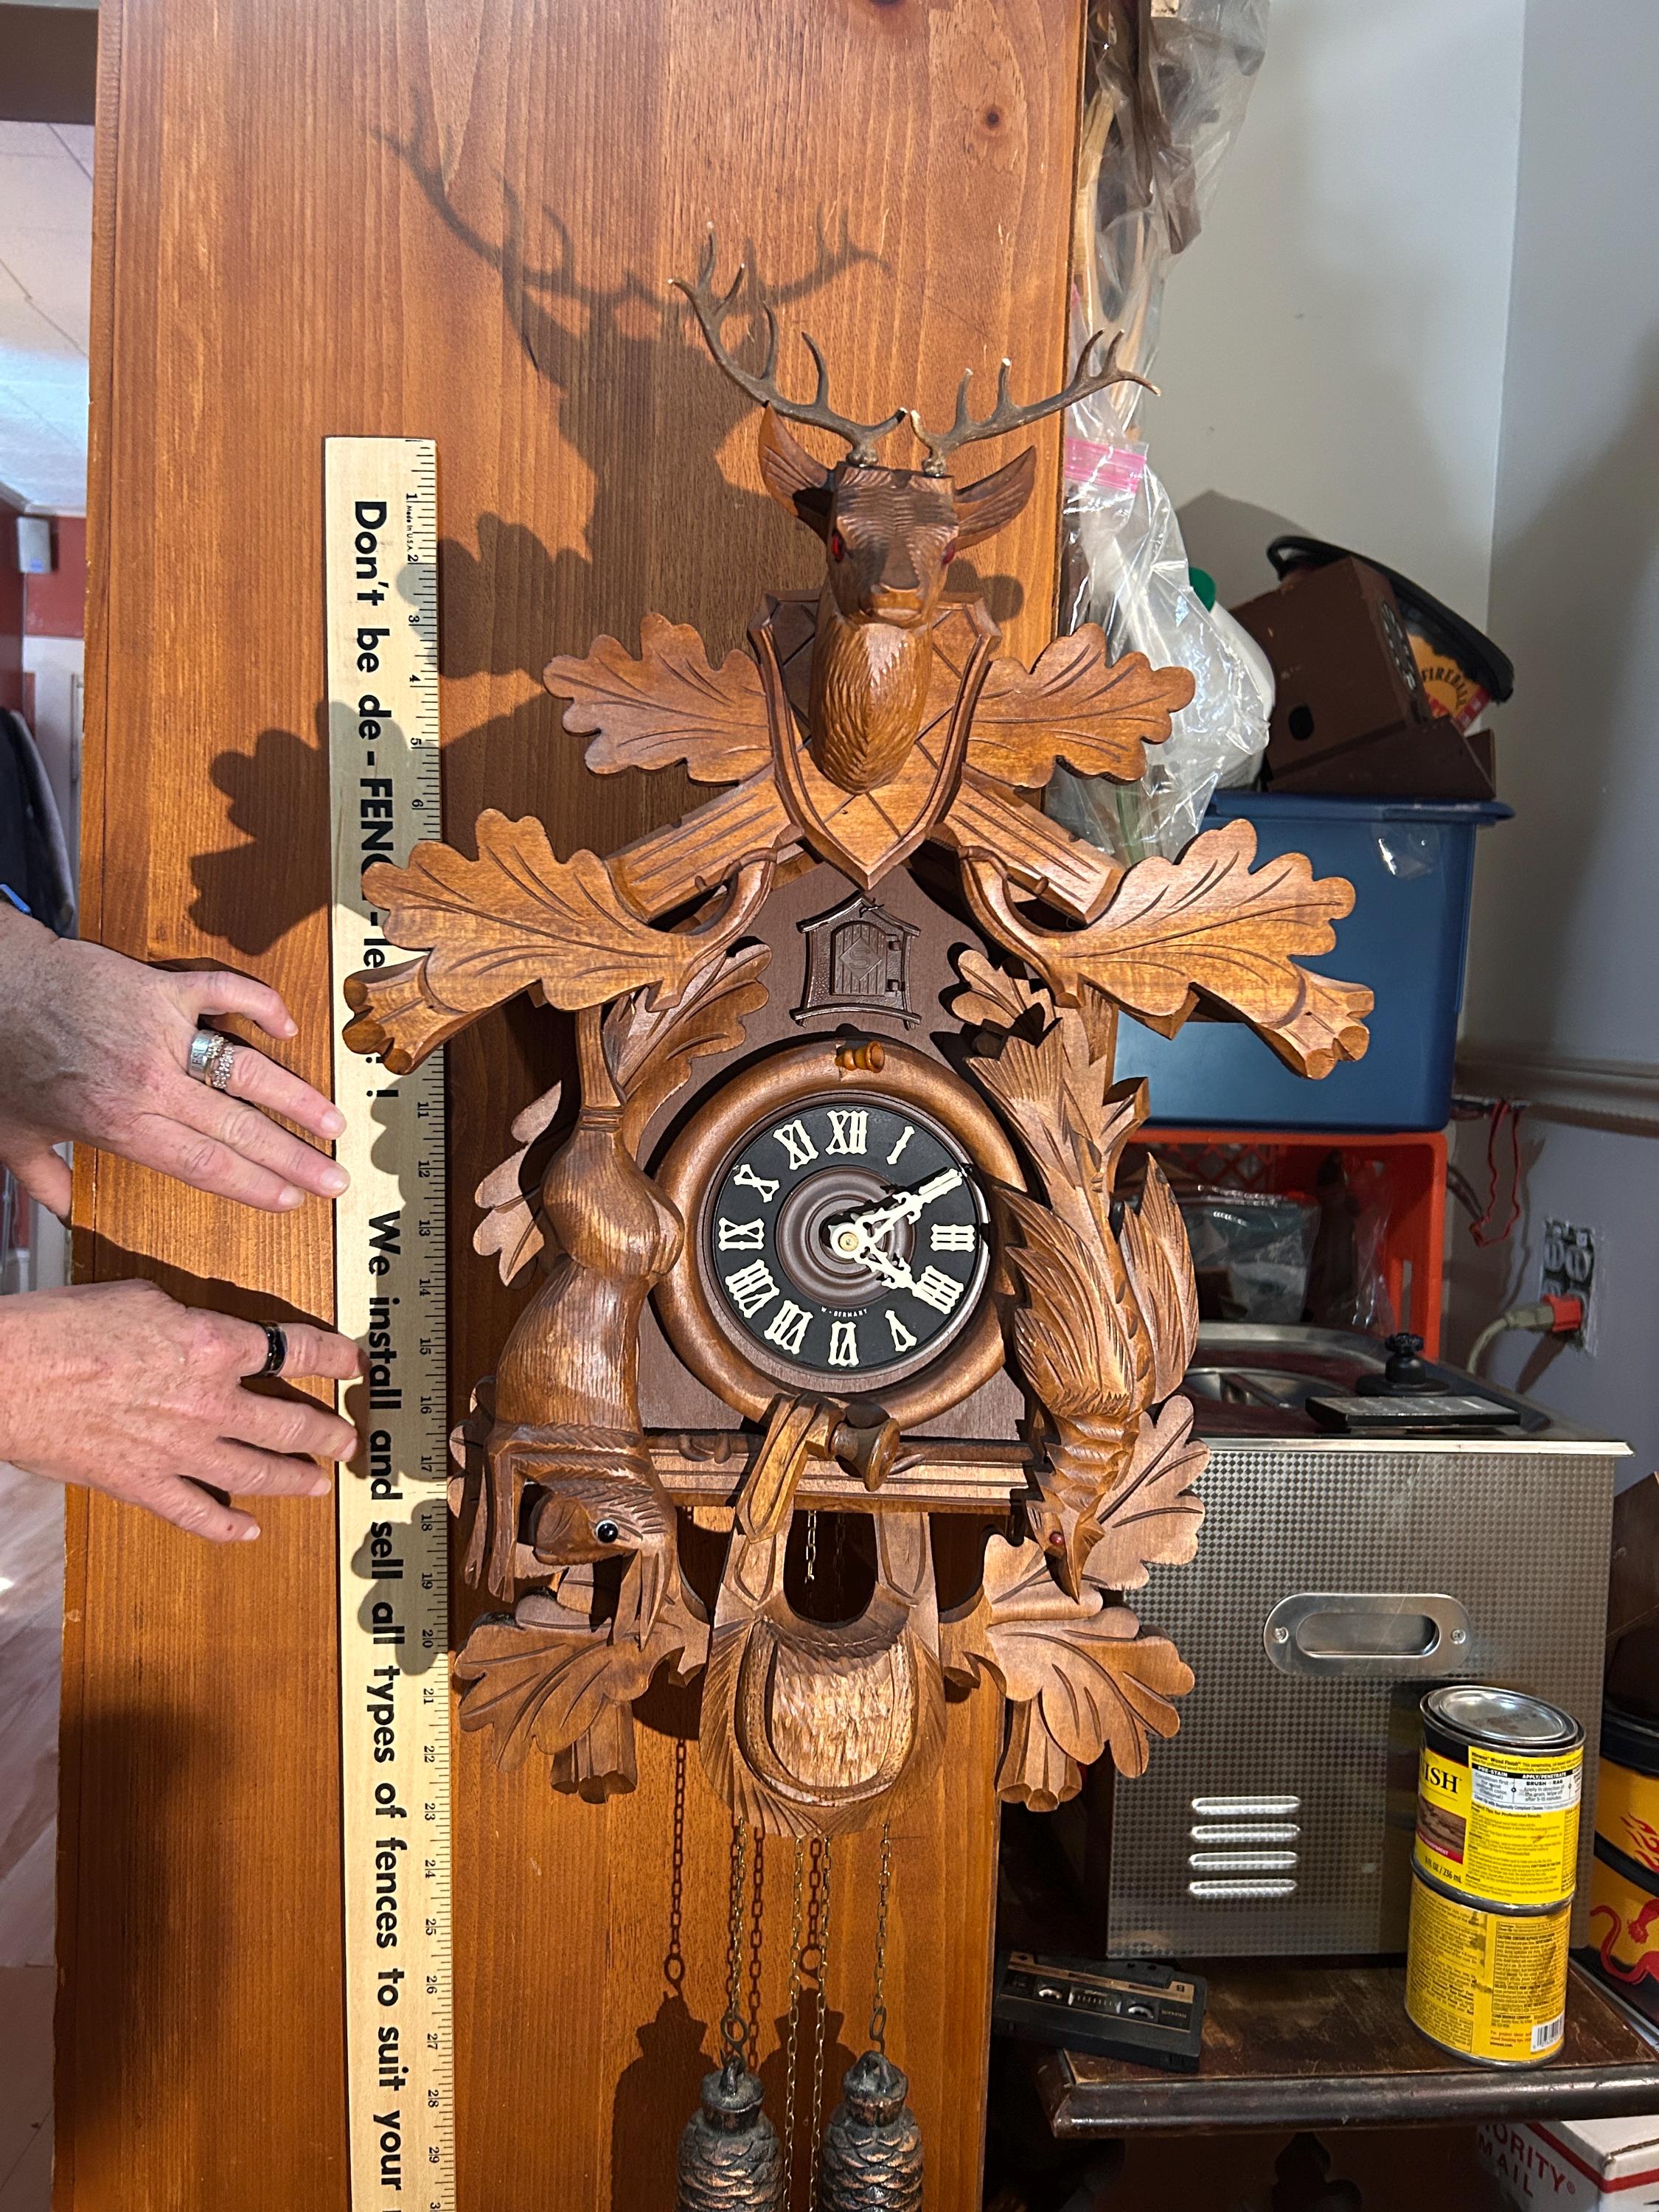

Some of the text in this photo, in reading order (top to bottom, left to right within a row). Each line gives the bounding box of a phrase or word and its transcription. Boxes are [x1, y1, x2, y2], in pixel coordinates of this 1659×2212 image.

[355, 501, 389, 606] Don't
[407, 554, 419, 562] 2
[408, 614, 420, 623] 3
[357, 627, 390, 672] be
[409, 674, 421, 683] 4
[358, 695, 392, 740] de
[410, 737, 422, 745] 5
[411, 799, 424, 808] 6
[417, 1101, 429, 1119] 11
[773, 1119, 819, 1171] XI
[825, 1110, 869, 1155] XII
[886, 1125, 915, 1165] I
[418, 1160, 431, 1178] 12
[733, 1164, 780, 1203] X
[369, 1210, 401, 1276] We
[419, 1220, 431, 1237] 13
[718, 1217, 765, 1251] IX
[931, 1223, 976, 1252] III
[419, 1279, 431, 1297] 14
[725, 1259, 780, 1319] VIII
[764, 1299, 814, 1355] VII
[833, 1308, 867, 1318] GERMANY
[827, 1321, 860, 1367] VI
[885, 1310, 918, 1352] V
[369, 1296, 403, 1410] install
[420, 1338, 432, 1356] 15
[420, 1396, 432, 1414] 16
[369, 1430, 403, 1500] and
[420, 1455, 433, 1473] 17
[421, 1514, 433, 1531] 18
[370, 1521, 404, 1579] sell
[421, 1573, 434, 1590] 19
[372, 1601, 405, 1644] all
[422, 1629, 434, 1649] 20
[423, 1688, 434, 1705] 21
[366, 1665, 400, 1763] types
[424, 1745, 435, 1763] 22
[375, 1783, 407, 1818] of
[424, 1803, 437, 1821] 23
[425, 1860, 437, 1879] 24
[375, 1837, 408, 1949] fences
[425, 1919, 437, 1936] 25
[378, 1968, 405, 2006] to
[426, 1975, 438, 1994] 26
[427, 2033, 438, 2051] 27
[378, 2027, 409, 2091] suit
[428, 2089, 439, 2108] 28
[373, 2110, 402, 2191] your
[428, 2146, 440, 2163] 29
[1478, 2132, 1534, 2198] MAIL
[1486, 2124, 1566, 2194] ORITY
